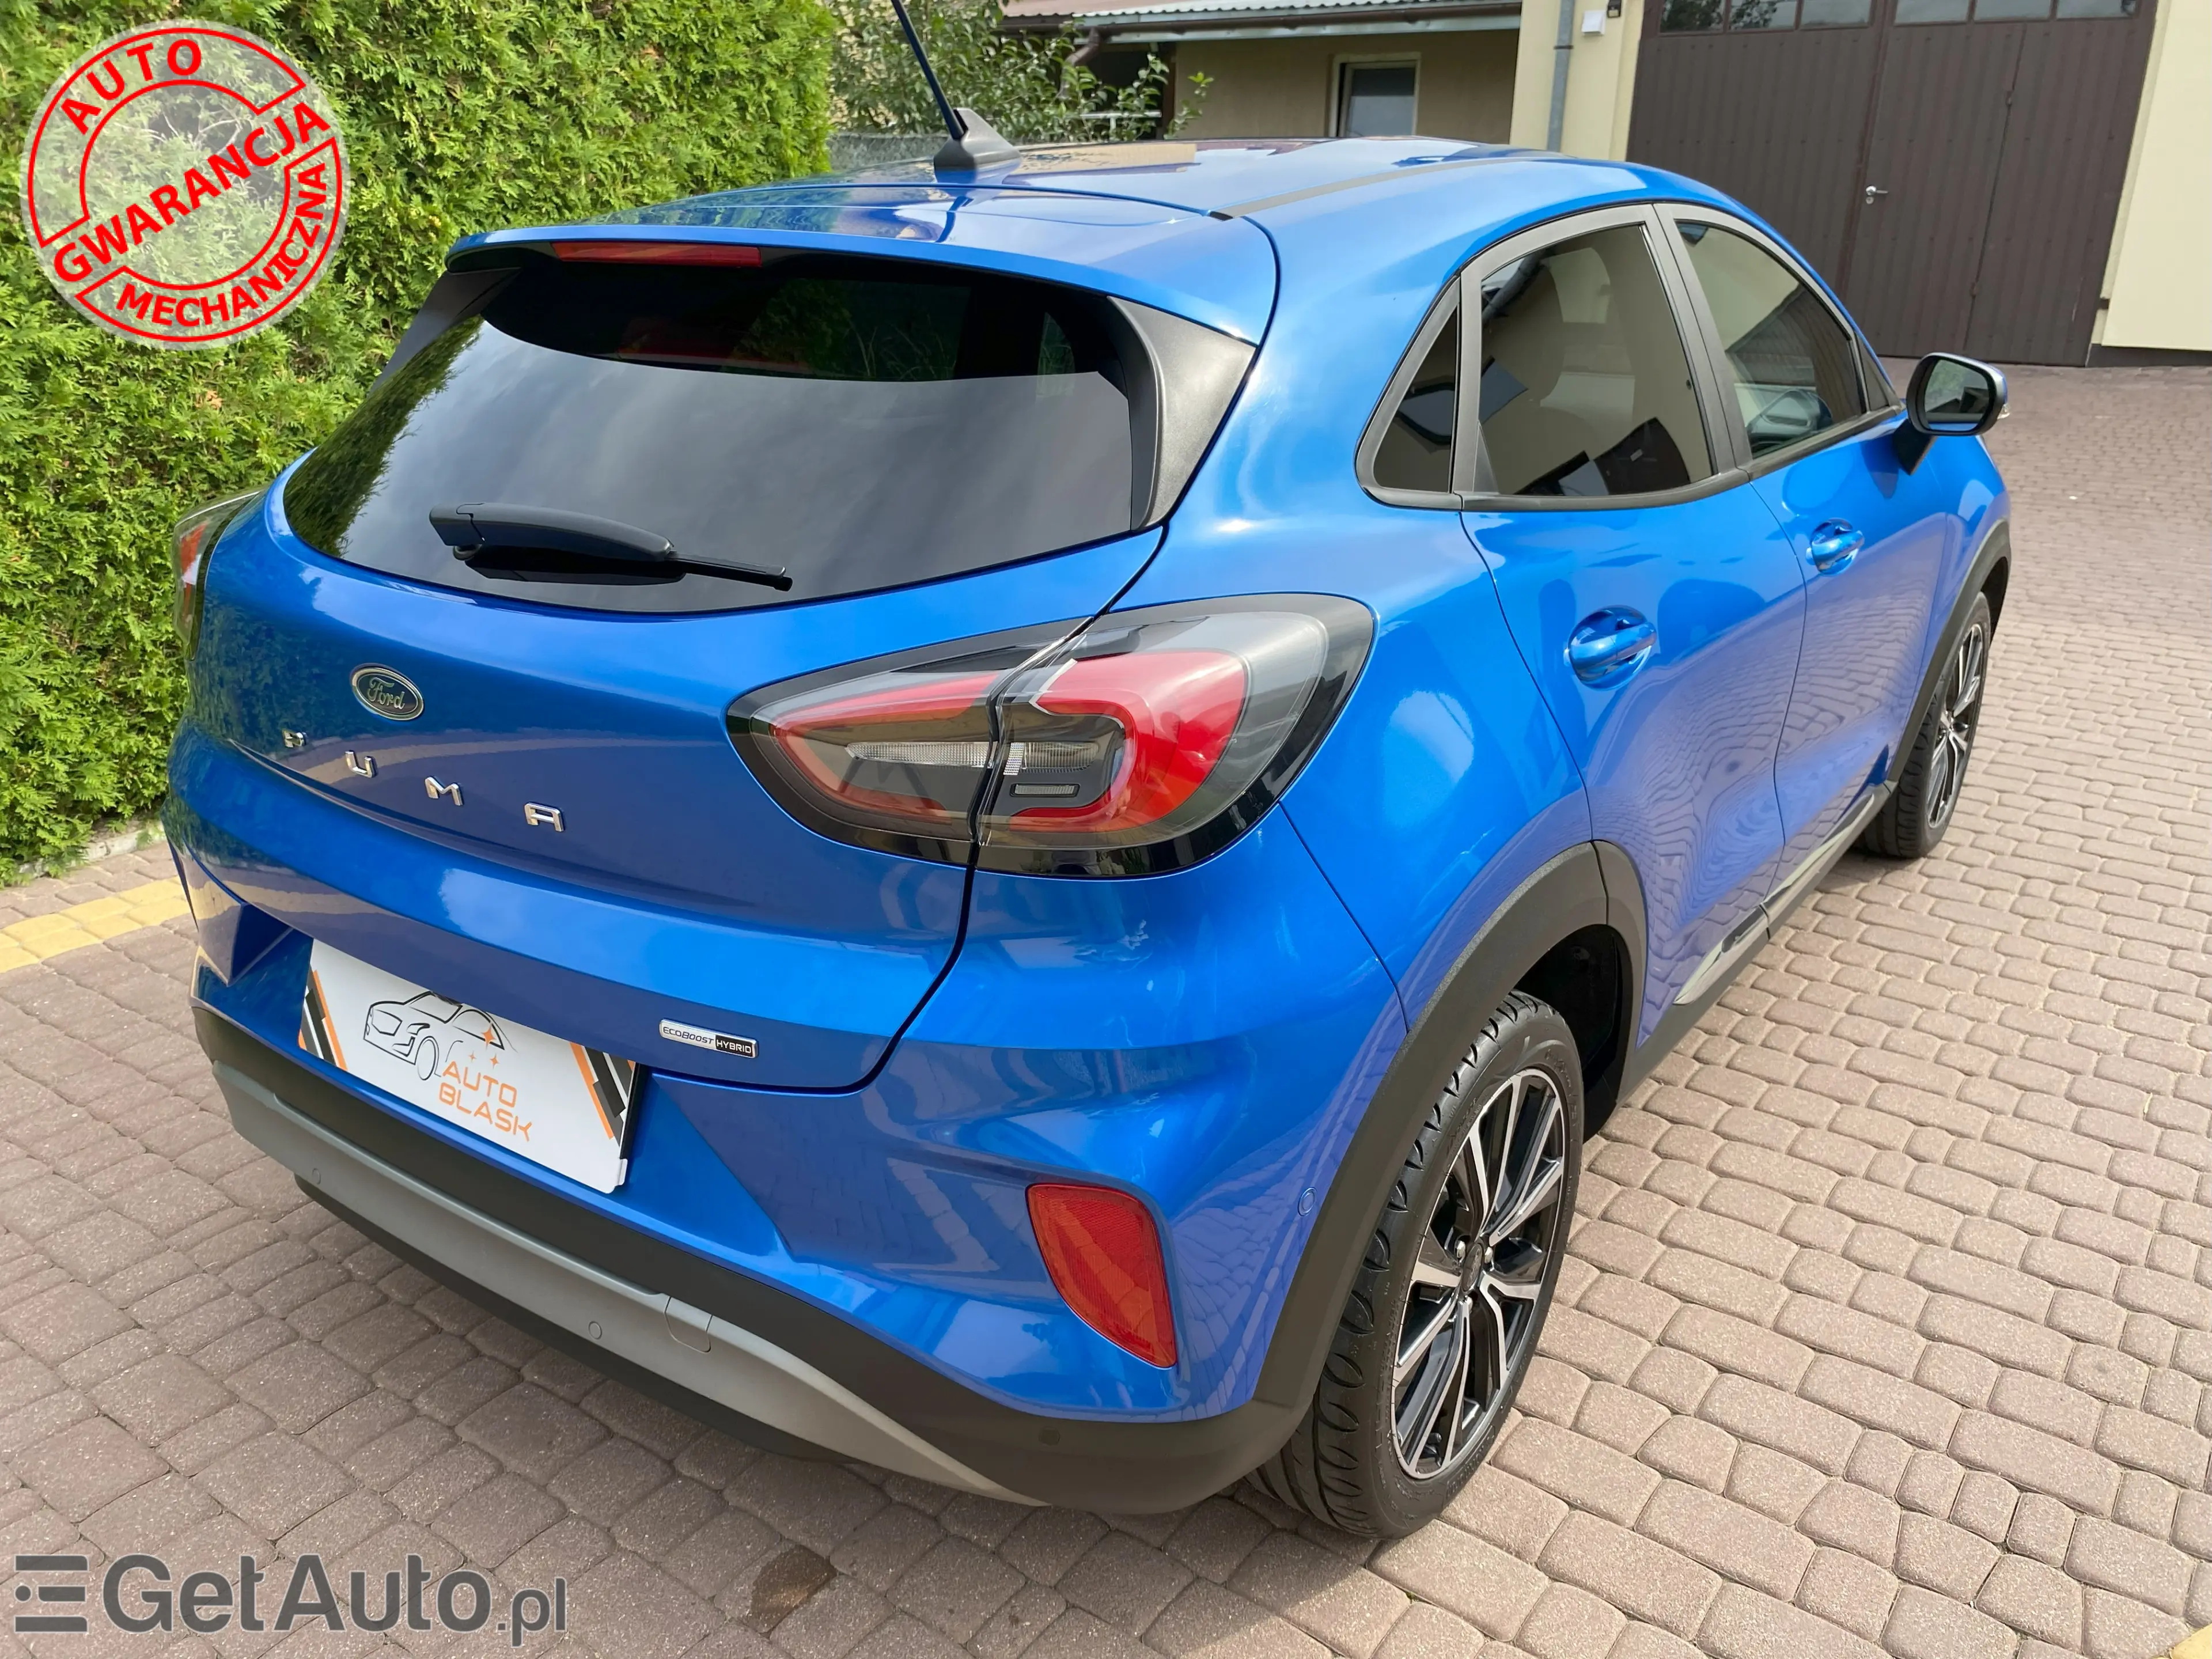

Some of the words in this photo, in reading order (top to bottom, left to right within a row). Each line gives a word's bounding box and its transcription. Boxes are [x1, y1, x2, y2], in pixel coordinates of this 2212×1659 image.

[367, 677, 406, 710] Ford
[716, 1039, 752, 1054] HYBRID
[442, 1060, 517, 1108] AUTO
[439, 1082, 533, 1142] BLASK
